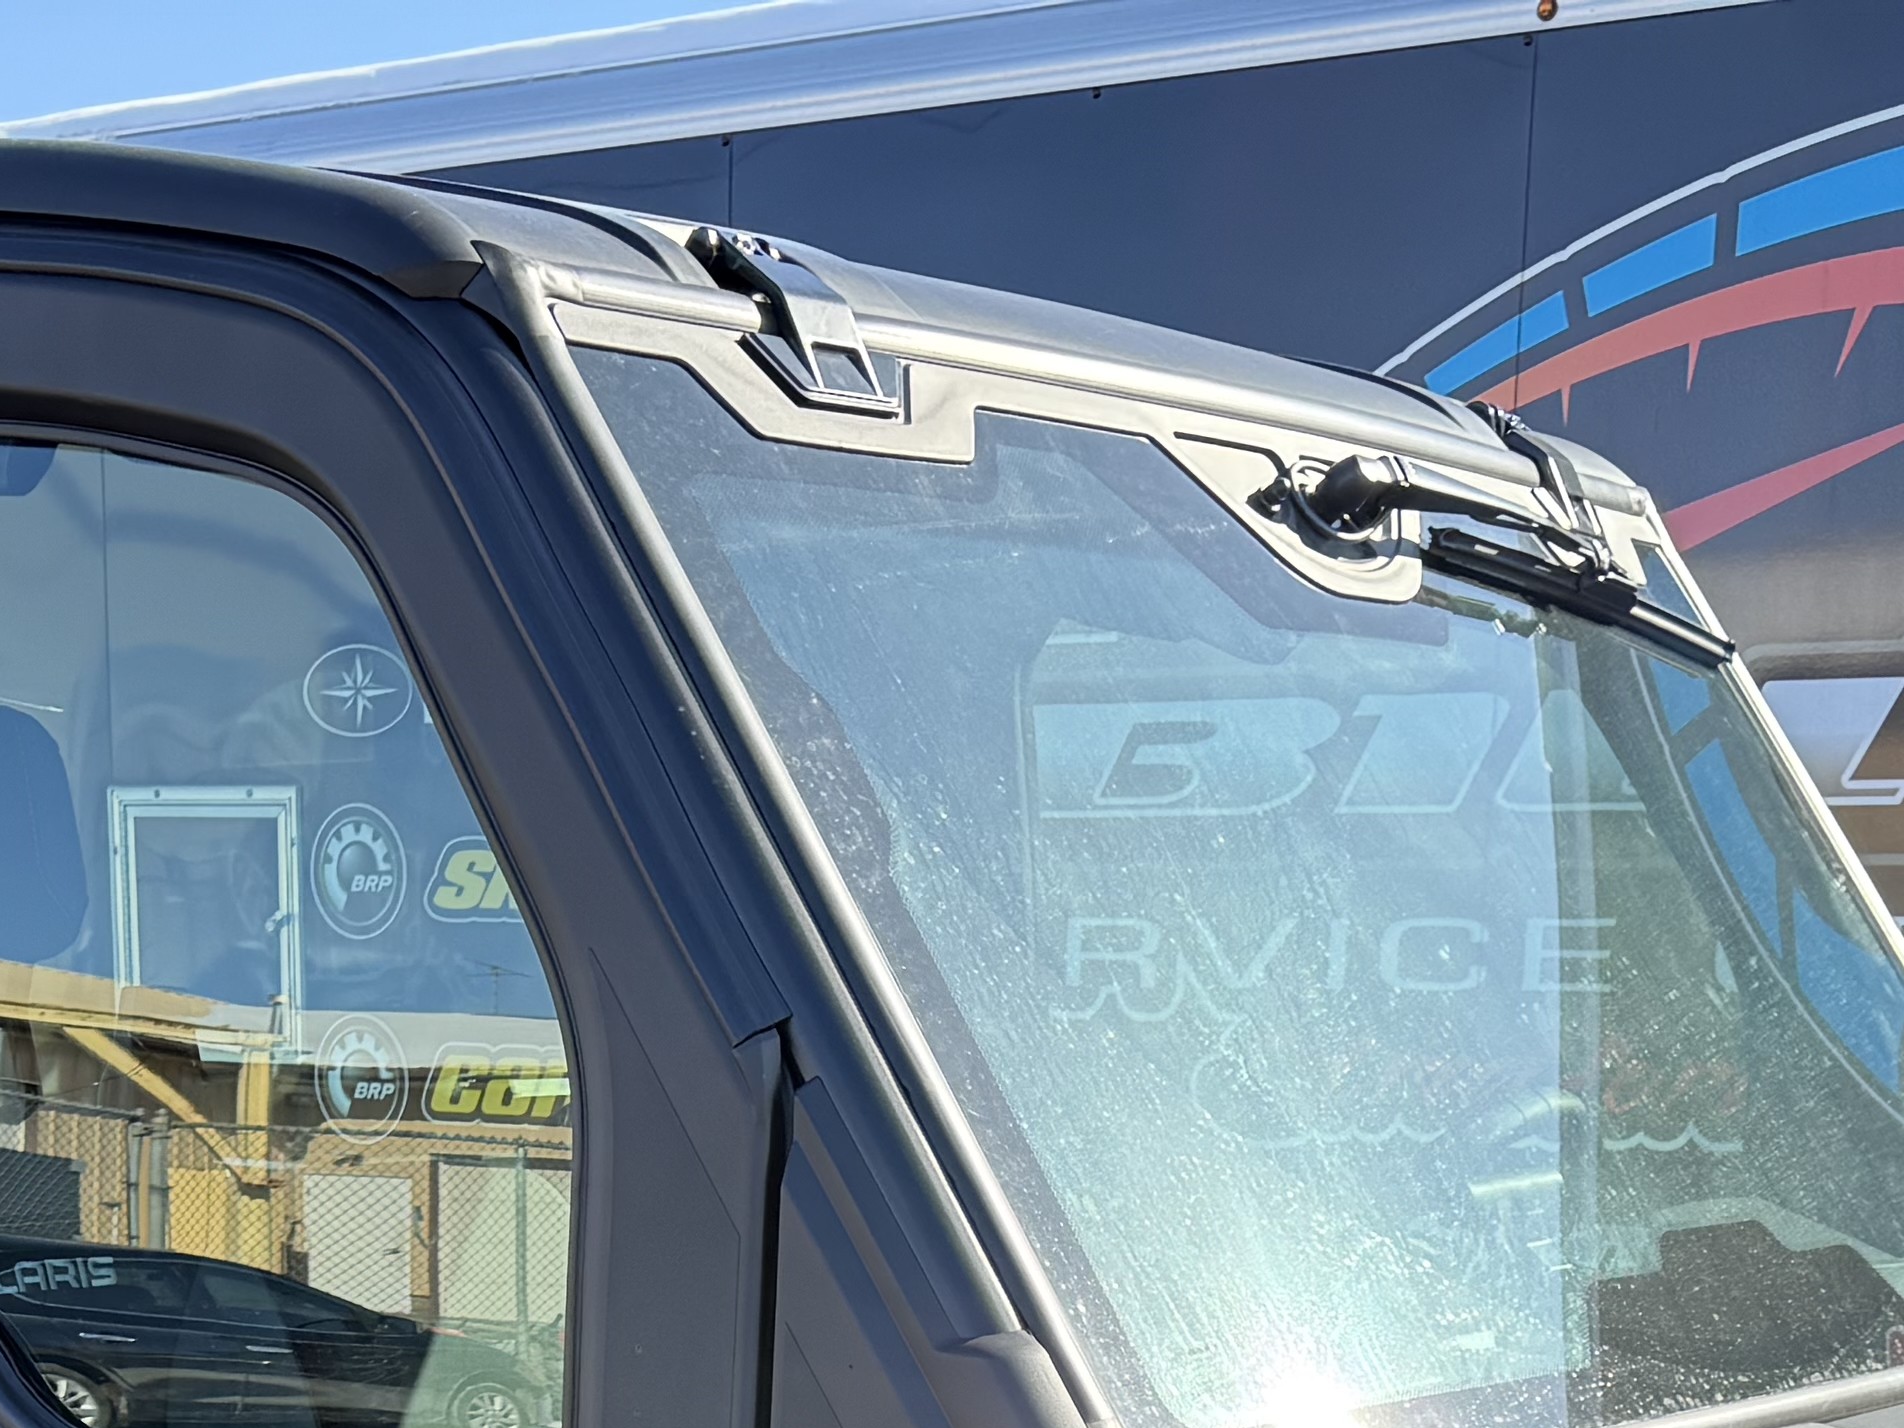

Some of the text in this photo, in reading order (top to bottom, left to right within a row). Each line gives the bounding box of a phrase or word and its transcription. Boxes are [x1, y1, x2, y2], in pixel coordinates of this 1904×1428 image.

[350, 874, 393, 894] BRP
[1064, 915, 1617, 994] RVICE
[353, 1080, 395, 1101] BRP
